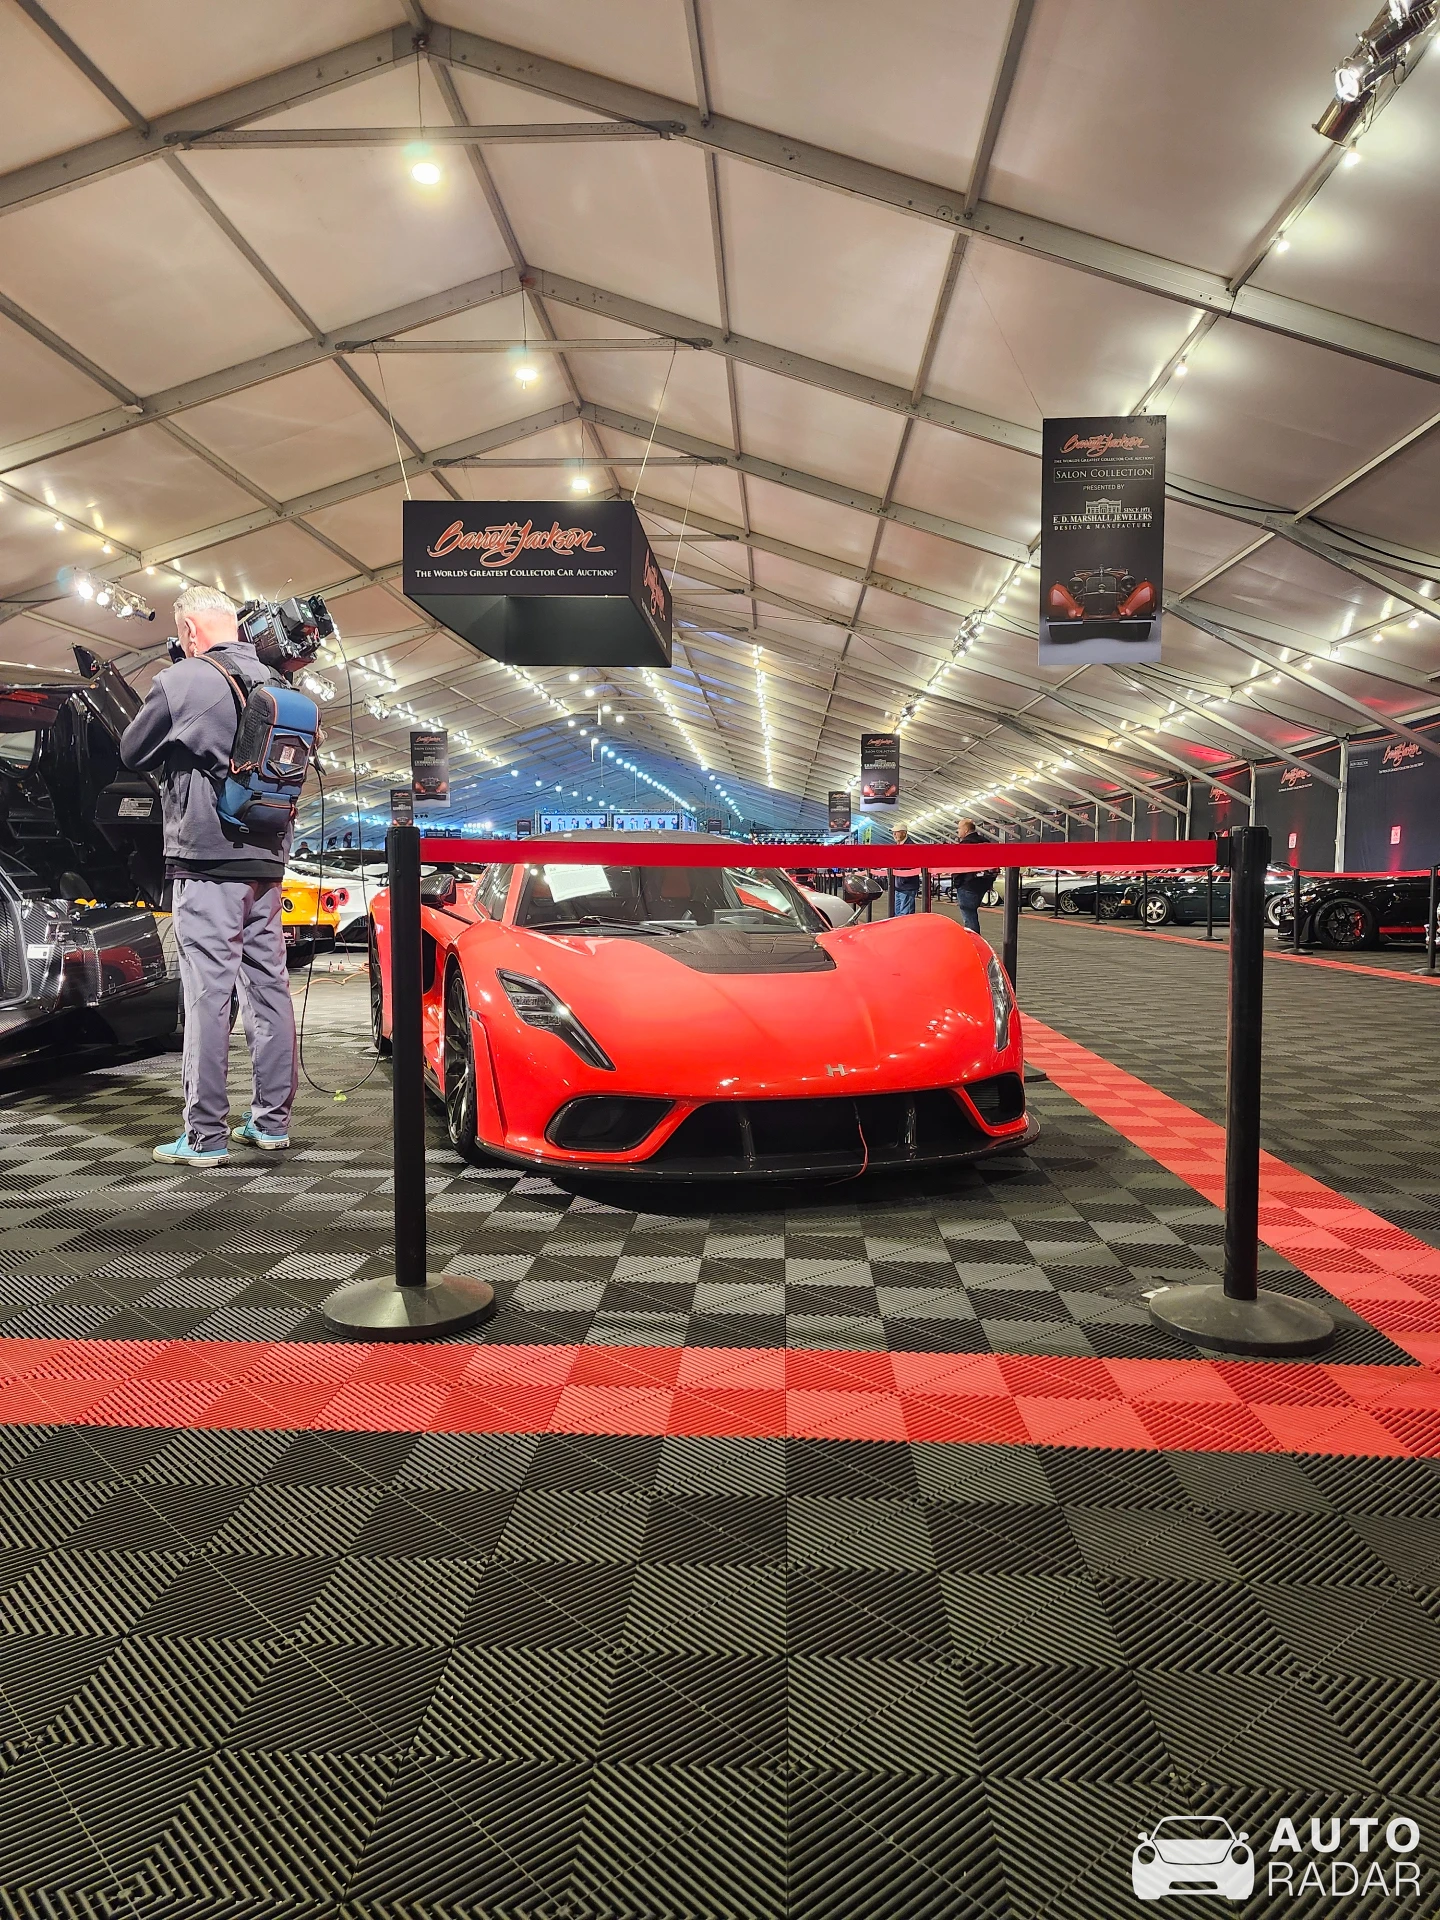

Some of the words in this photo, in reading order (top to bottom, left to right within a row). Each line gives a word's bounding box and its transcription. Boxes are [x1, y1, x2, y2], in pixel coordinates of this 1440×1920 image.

[1055, 469, 1087, 479] SALON
[1090, 468, 1152, 479] COLLECTION
[1070, 514, 1112, 523] MARSHALL
[1113, 513, 1153, 522] JEWELERS
[1095, 522, 1152, 530] MANUFACTURE
[427, 519, 605, 567] Barrett-Jackson
[415, 570, 432, 578] THE
[433, 569, 468, 578] WORLD'S
[469, 569, 508, 577] GREATEST
[509, 569, 556, 577] COLLECTOR
[557, 568, 574, 577] CAR
